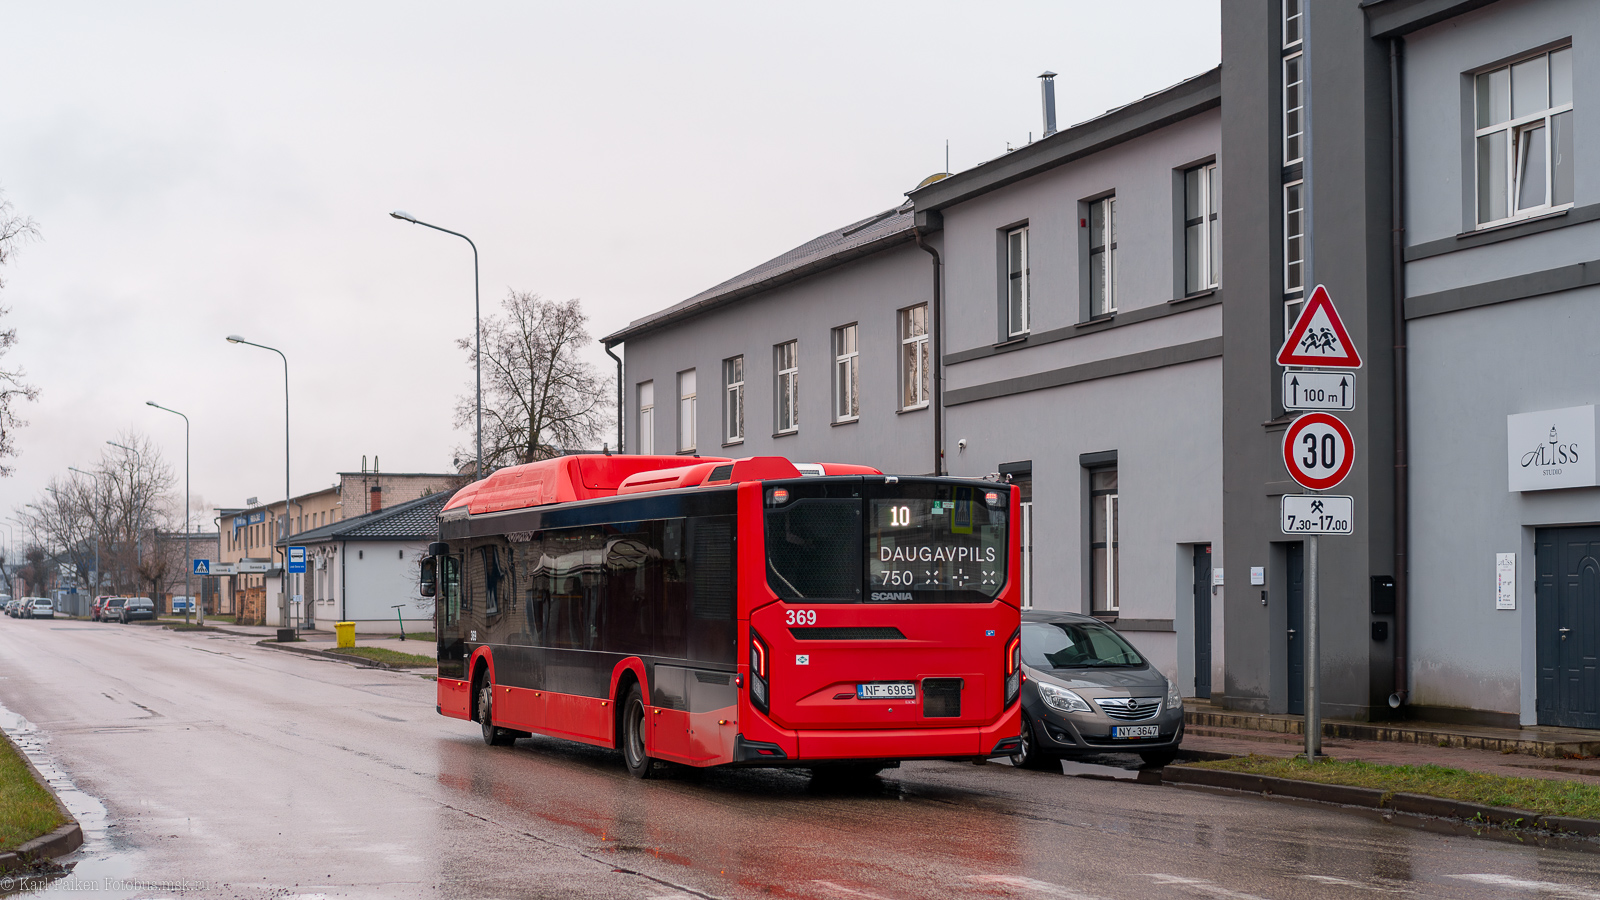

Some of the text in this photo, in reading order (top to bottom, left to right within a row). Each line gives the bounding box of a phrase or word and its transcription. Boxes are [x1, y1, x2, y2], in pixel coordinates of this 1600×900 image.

[1303, 388, 1338, 403] 100 m
[1302, 433, 1336, 469] 30
[1520, 442, 1579, 467] ALISS
[890, 506, 910, 526] 10
[880, 546, 996, 562] DAUGAVPILS
[880, 570, 914, 586] 750
[870, 592, 913, 601] SCANIA
[785, 609, 817, 625] 369
